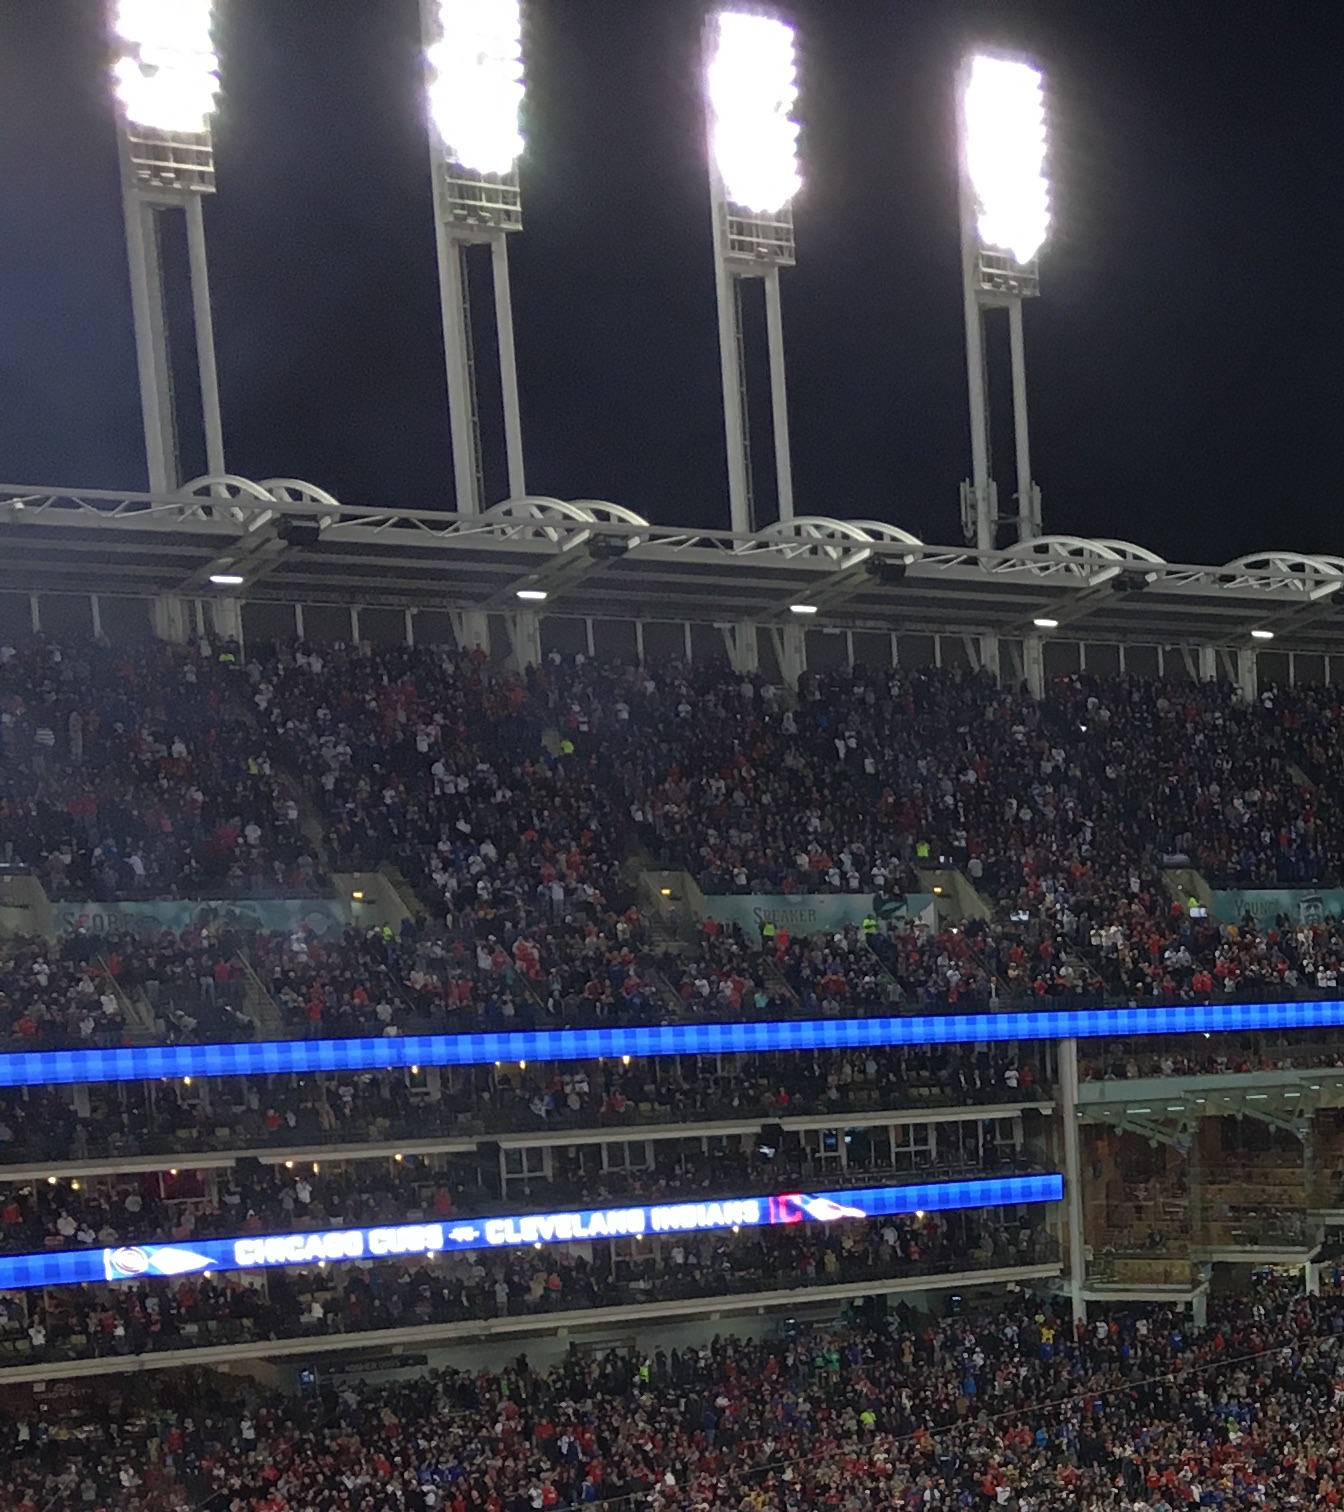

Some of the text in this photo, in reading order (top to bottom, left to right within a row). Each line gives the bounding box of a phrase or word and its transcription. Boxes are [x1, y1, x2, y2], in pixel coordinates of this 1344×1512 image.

[753, 906, 817, 925] SPEAKER
[234, 1230, 363, 1266] CHICAGO
[485, 1207, 645, 1246] CLEVELAND
[651, 1199, 760, 1230] INDIANS
